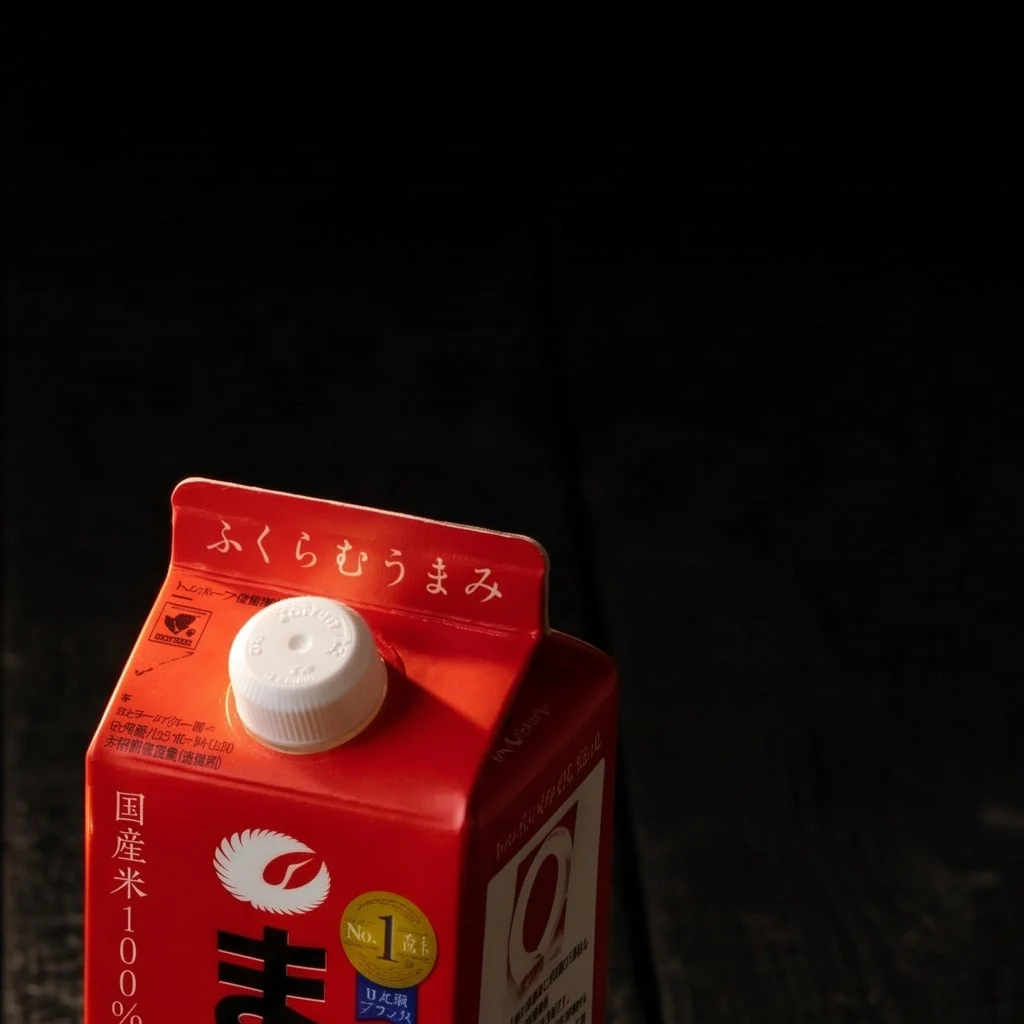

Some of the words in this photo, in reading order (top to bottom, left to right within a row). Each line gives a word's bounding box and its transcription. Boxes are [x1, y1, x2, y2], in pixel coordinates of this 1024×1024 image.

[206, 520, 504, 603] ふくらむうまみ
